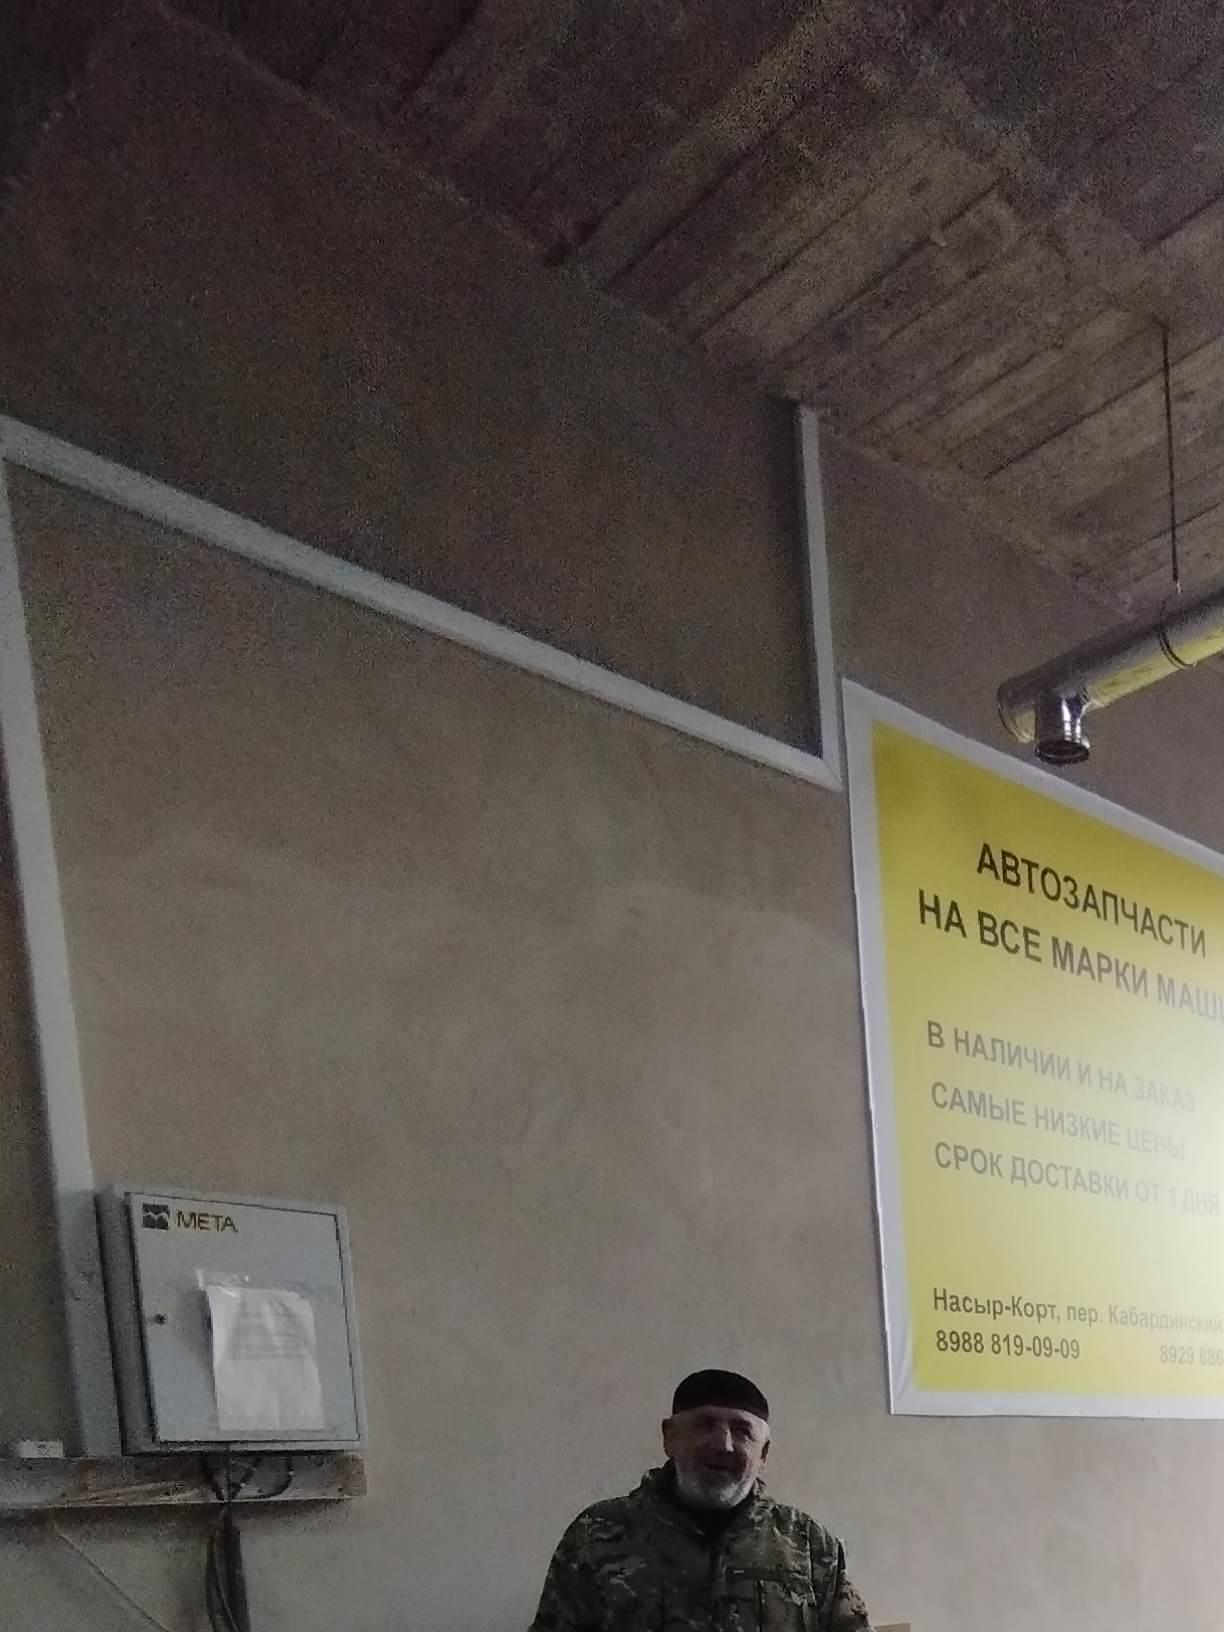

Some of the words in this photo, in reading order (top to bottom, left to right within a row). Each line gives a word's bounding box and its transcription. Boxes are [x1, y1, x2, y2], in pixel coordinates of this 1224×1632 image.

[976, 842, 1206, 959] АВТОЗАПЧАСТИ
[918, 889, 967, 939] НА
[977, 911, 1042, 963] ВСЕ
[1052, 936, 1148, 997] МАРКИ
[927, 1021, 945, 1049] В
[954, 1027, 1071, 1082] НАЛИЧИИ
[1078, 1061, 1092, 1087] И
[1099, 1067, 1128, 1097] НА
[1134, 1076, 1196, 1112] ЗАКАЗ
[931, 1082, 1025, 1126] САМЫЕ
[1035, 1107, 1121, 1146] НИЗКИЕ
[1127, 1124, 1185, 1160] ЦЕНЫ
[935, 1142, 1003, 1178] СРОК
[1010, 1157, 1129, 1200] ДОСТАВКИ
[1135, 1180, 1160, 1205] ОТ
[1168, 1187, 1177, 1208] 1
[1183, 1188, 1221, 1217] ДНЯ
[933, 1288, 1061, 1323] Насыр-Корт,
[1067, 1305, 1103, 1328] пер.
[936, 1330, 984, 1354] 8988
[991, 1333, 1081, 1359] 819-09-09
[1160, 1345, 1194, 1365] 8929
